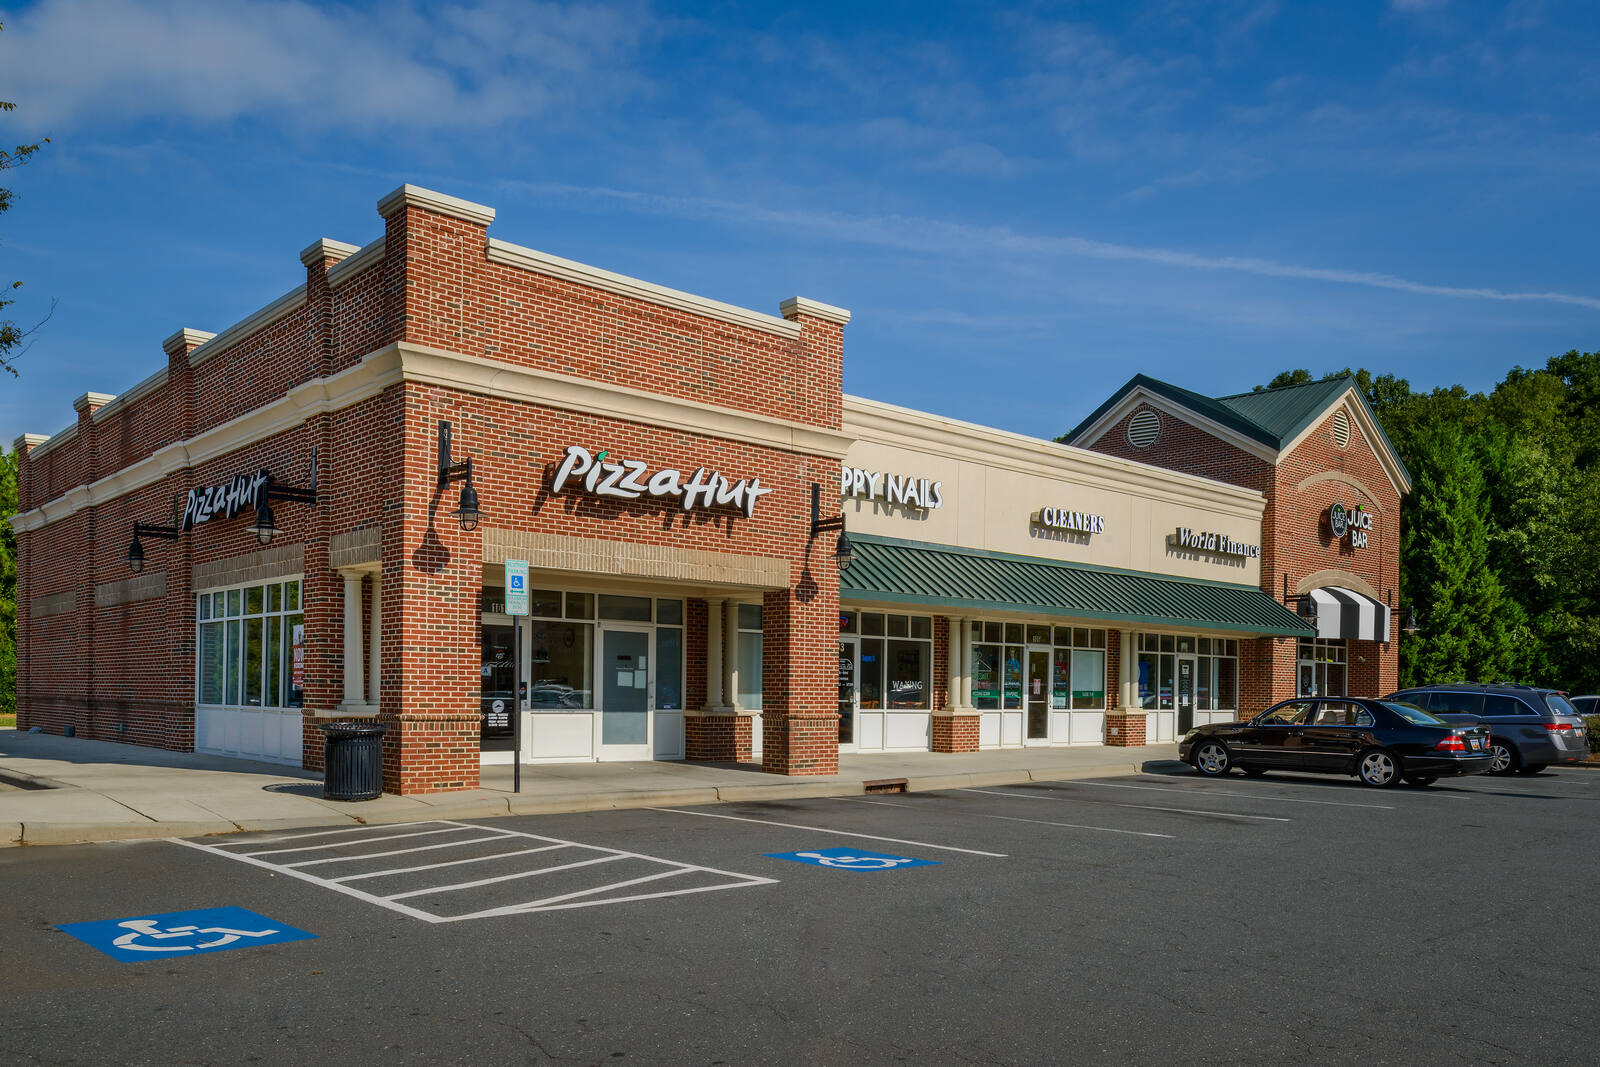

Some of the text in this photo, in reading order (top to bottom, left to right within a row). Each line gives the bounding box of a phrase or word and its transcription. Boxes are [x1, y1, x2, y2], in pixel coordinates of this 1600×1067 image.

[887, 472, 943, 509] NAILS
[1043, 506, 1105, 534] CLEANERS
[1332, 511, 1346, 521] JUICE
[1347, 509, 1373, 530] JUICE
[1180, 527, 1260, 558] World Finance
[1352, 530, 1368, 548] BAR
[892, 680, 923, 690] WAXING
